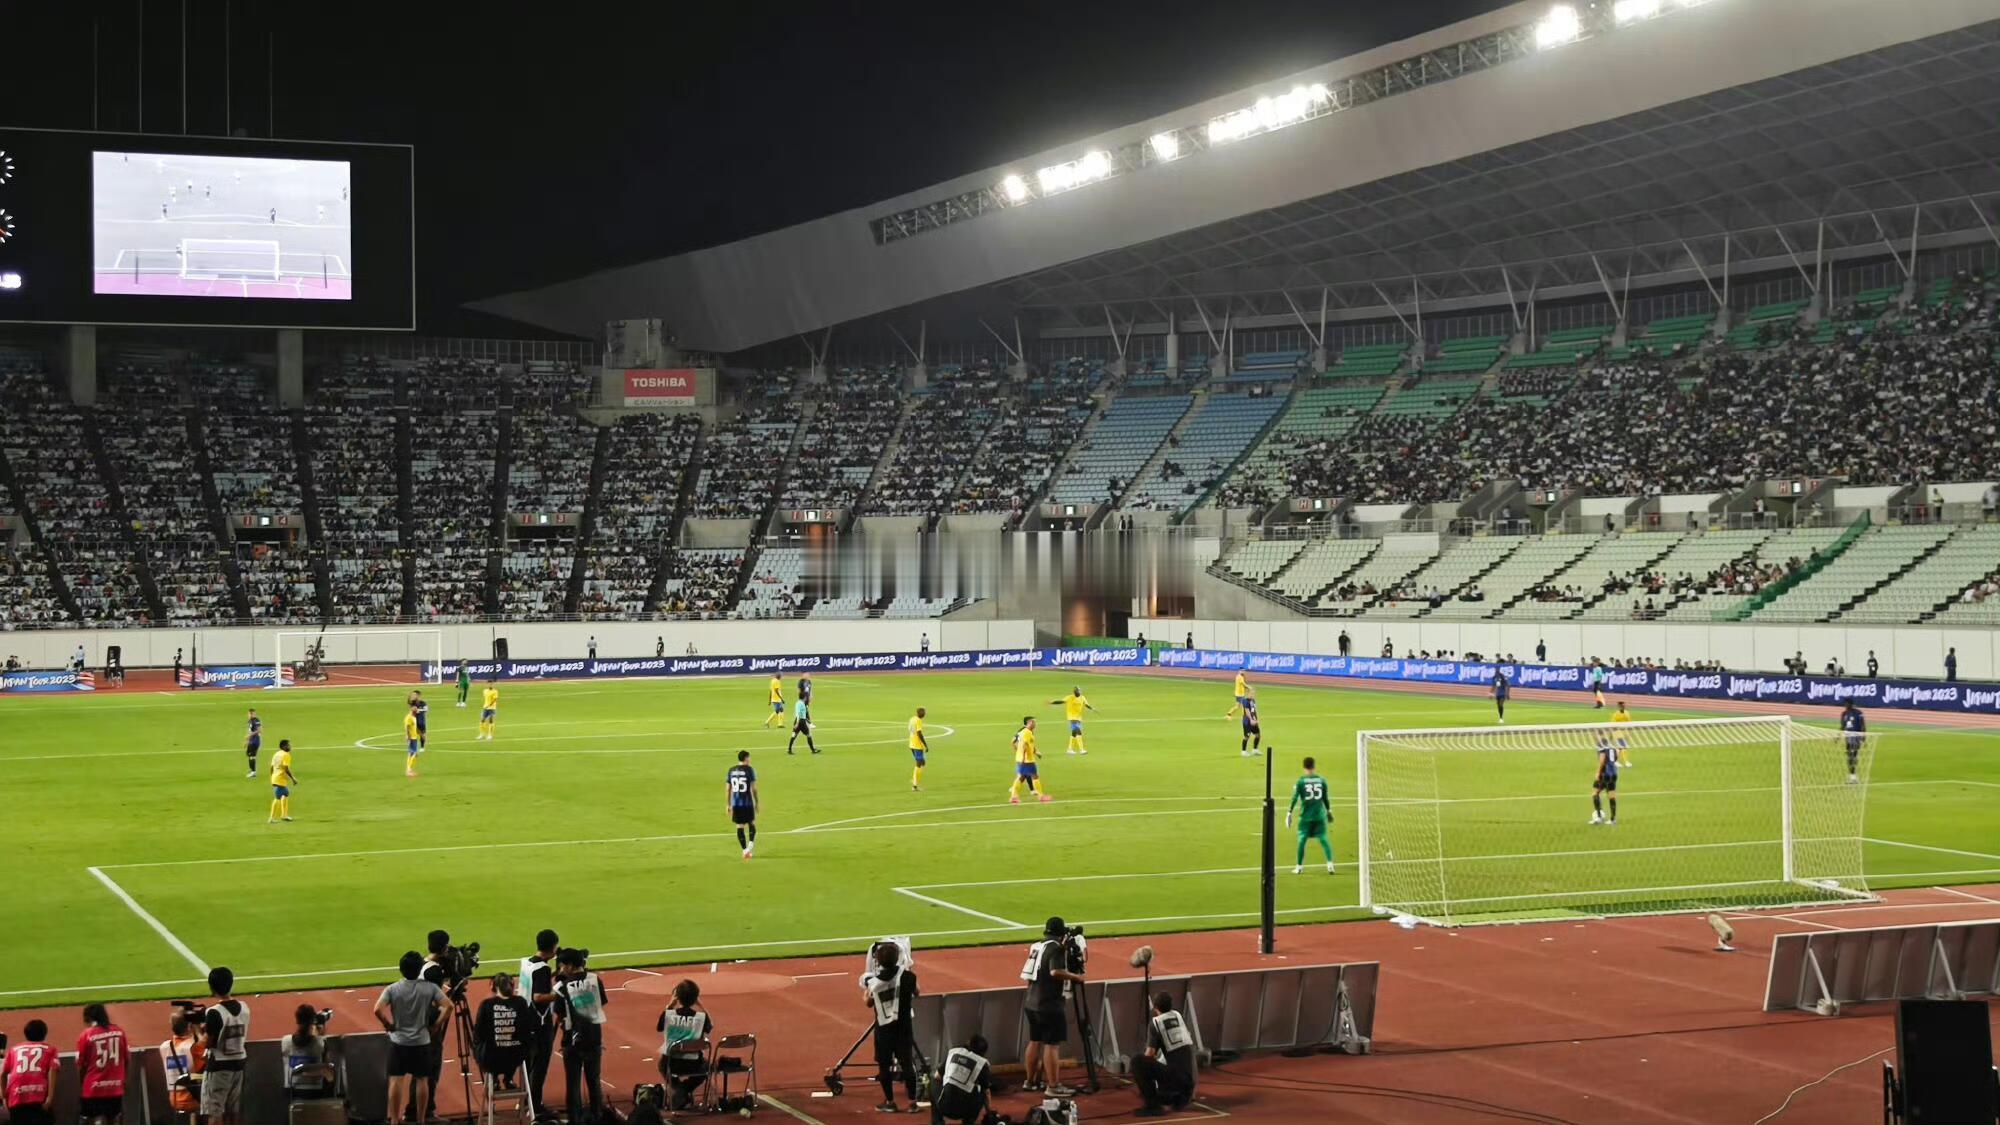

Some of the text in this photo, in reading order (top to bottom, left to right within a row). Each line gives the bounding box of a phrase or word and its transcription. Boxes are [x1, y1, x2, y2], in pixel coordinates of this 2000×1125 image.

[631, 377, 687, 388] TOSHIBA
[750, 656, 820, 671] JAPAN TOUR 2023
[826, 655, 896, 669] JAPAN TOUR 2023
[901, 653, 970, 667] JAPAN TOUR 2023
[976, 651, 1042, 666] JAPAN TOUR 2023
[1052, 649, 1088, 665] JAPAN
[1087, 649, 1113, 665] TOUR
[1113, 649, 1138, 661] 2023
[508, 662, 584, 676] JAPAN TOUR 2023
[590, 660, 666, 674] JAPAN TOUR 2023
[670, 658, 744, 672] JAPAN TOUR 2023
[0, 674, 77, 690] JAPAN TOUR 2023
[202, 669, 276, 683] JAPAN TOUR 2023
[1583, 669, 1608, 688] JAN
[1625, 671, 1648, 685] 2023
[1653, 673, 1721, 693] JAPAN TOUR 2023
[1727, 676, 1802, 698] JAPAN TOUR 2023
[1807, 681, 1877, 700] JAPAN TOUR 2023
[1882, 685, 1957, 704] JAPAN TOUR 2023
[1963, 688, 1995, 708] JAPAN
[731, 777, 748, 792] 95
[1305, 784, 1323, 800] 35
[670, 1015, 698, 1027] STAFF
[16, 1047, 42, 1073] 52
[96, 1038, 120, 1068] 54
